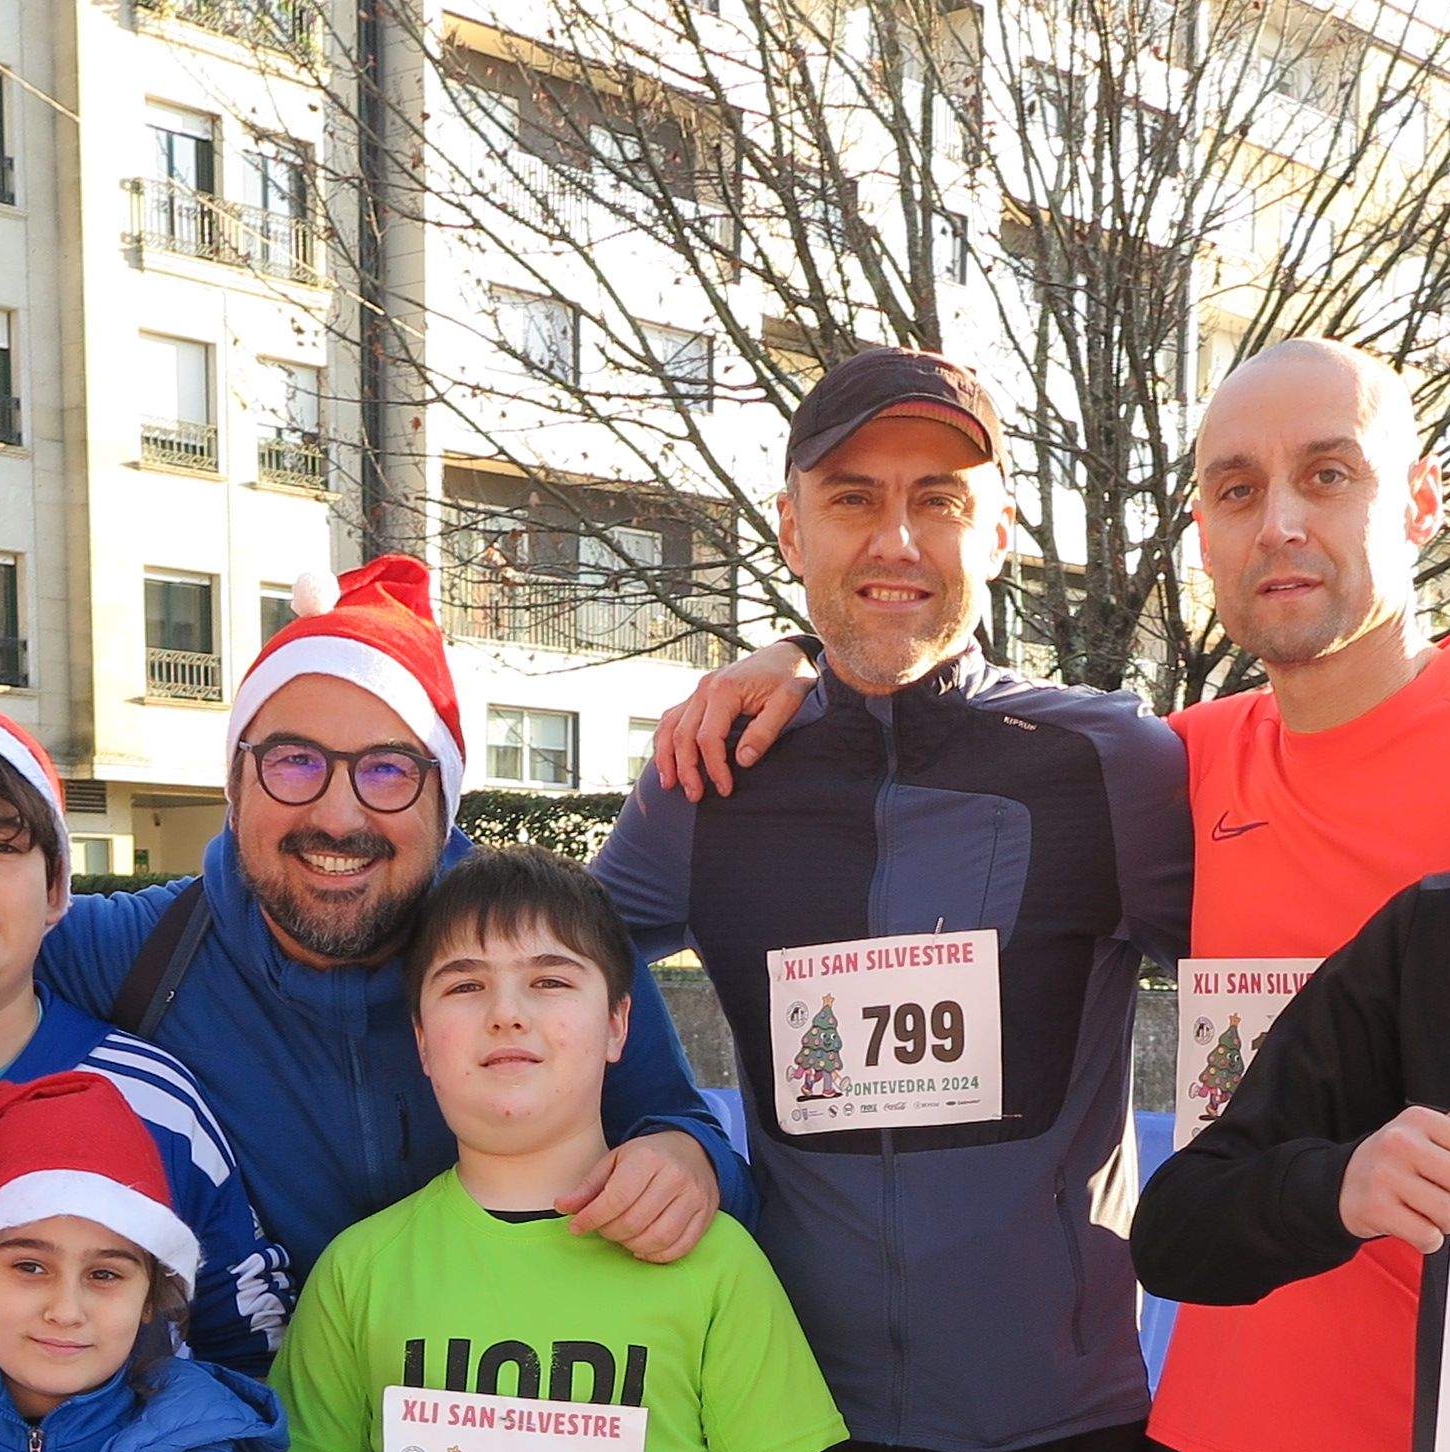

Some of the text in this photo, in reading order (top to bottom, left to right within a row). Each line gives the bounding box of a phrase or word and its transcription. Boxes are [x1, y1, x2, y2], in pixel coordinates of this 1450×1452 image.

[785, 942, 973, 980] XLI SAN SILVESTRE
[1193, 973, 1314, 994] XLI SAN SILV
[862, 1000, 965, 1067] 799
[846, 1075, 979, 1096] PONTEVEDRA 2024
[402, 1399, 622, 1438] XLI SAN SILVESTRE
